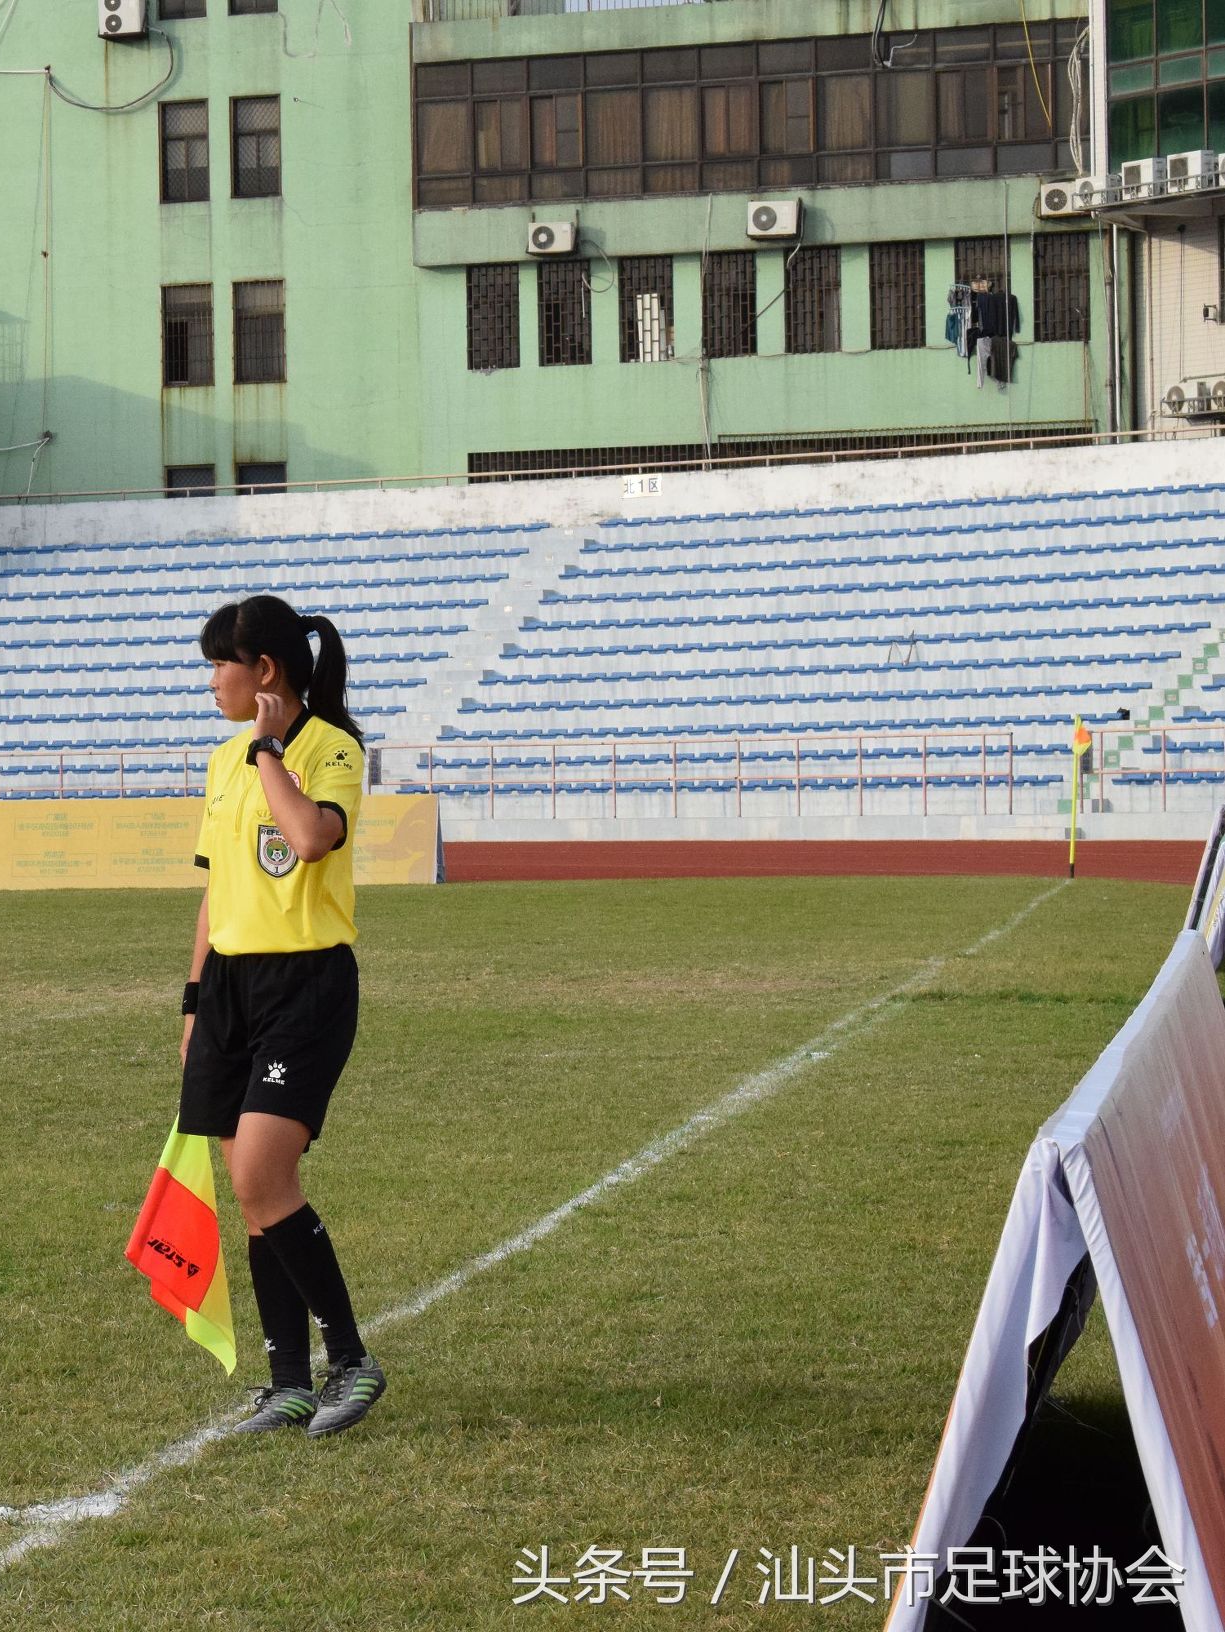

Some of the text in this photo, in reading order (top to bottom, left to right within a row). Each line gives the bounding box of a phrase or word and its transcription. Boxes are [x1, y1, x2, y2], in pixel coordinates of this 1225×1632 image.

[623, 478, 659, 494] 北1区
[325, 761, 353, 771] KELME
[262, 1077, 286, 1086] KELME
